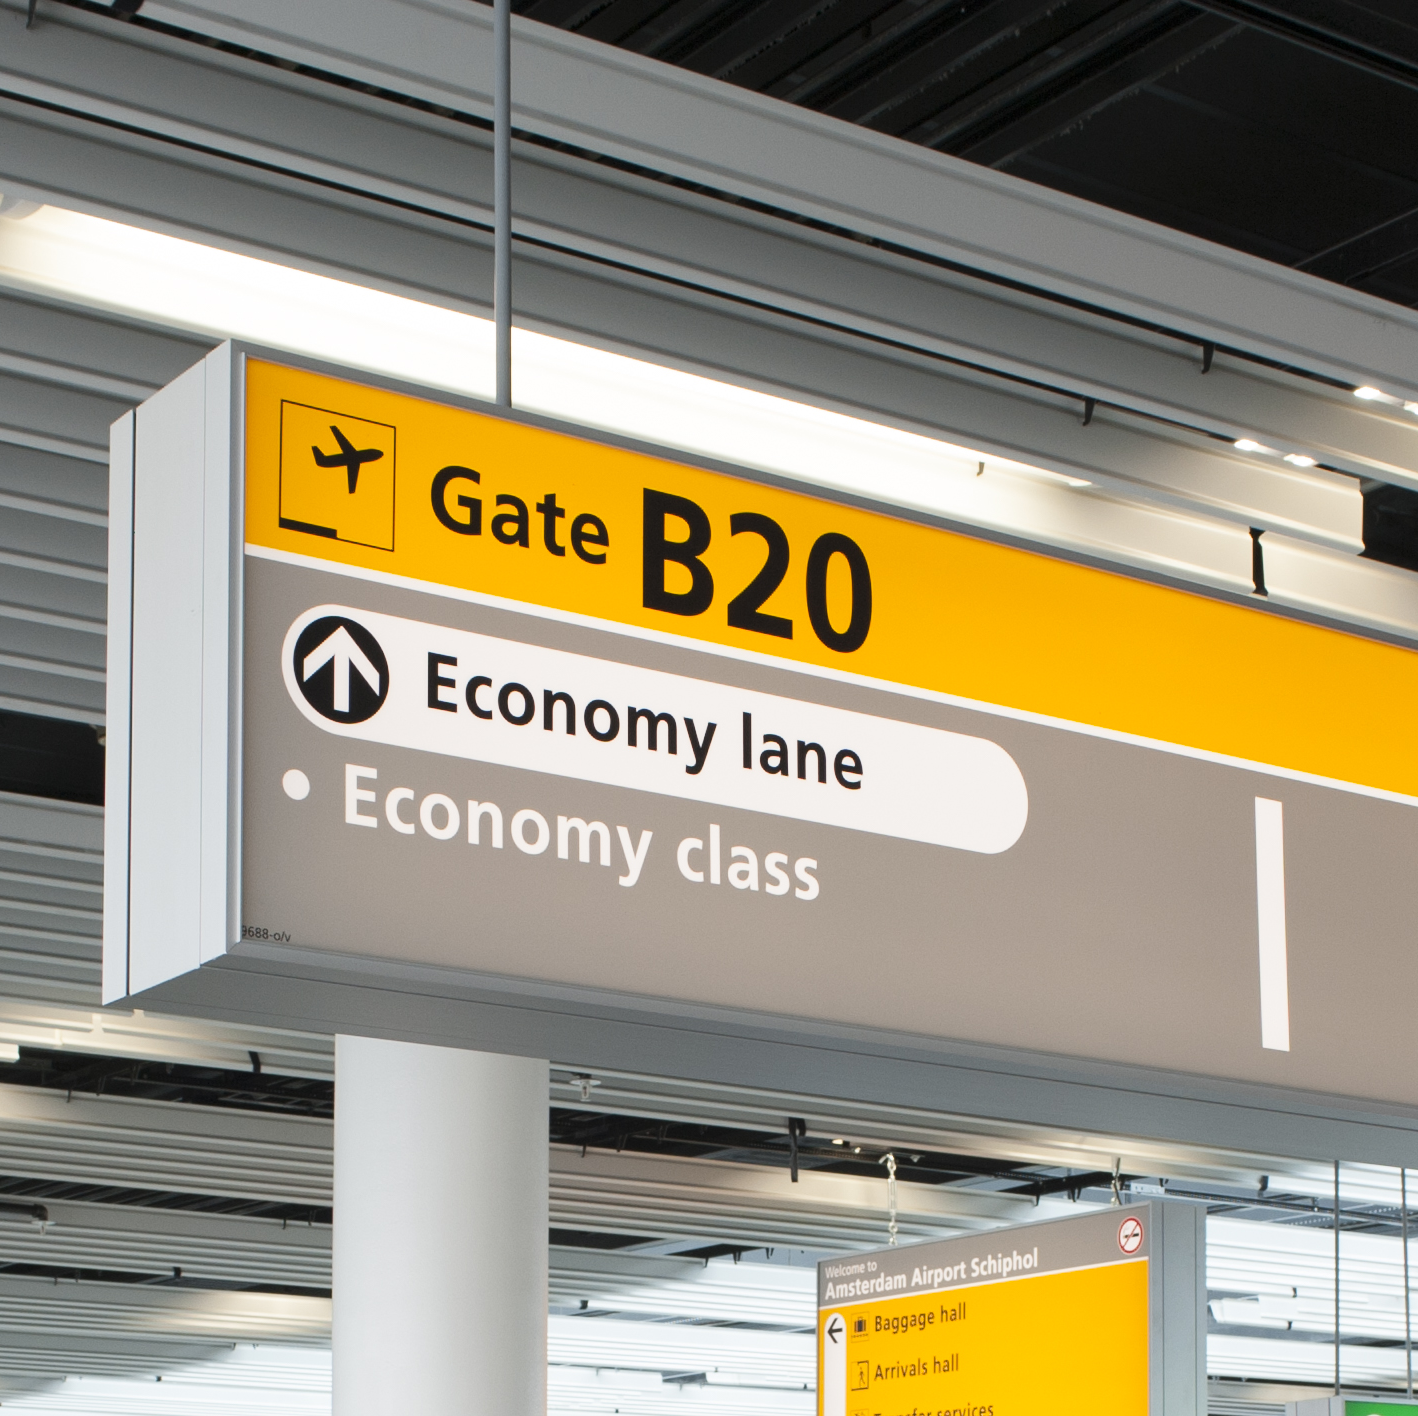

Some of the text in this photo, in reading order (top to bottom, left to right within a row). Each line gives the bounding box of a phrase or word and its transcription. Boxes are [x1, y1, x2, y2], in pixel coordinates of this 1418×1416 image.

[430, 464, 874, 653] Gate B20
[426, 653, 864, 791] Economy lane
[344, 764, 821, 902] Economy class
[825, 1259, 878, 1278] Welcome to
[825, 1247, 1038, 1300] Amsterdam Airport Schiphol
[874, 1302, 967, 1334] Baggage hall
[874, 1353, 959, 1382] Arrivals hall
